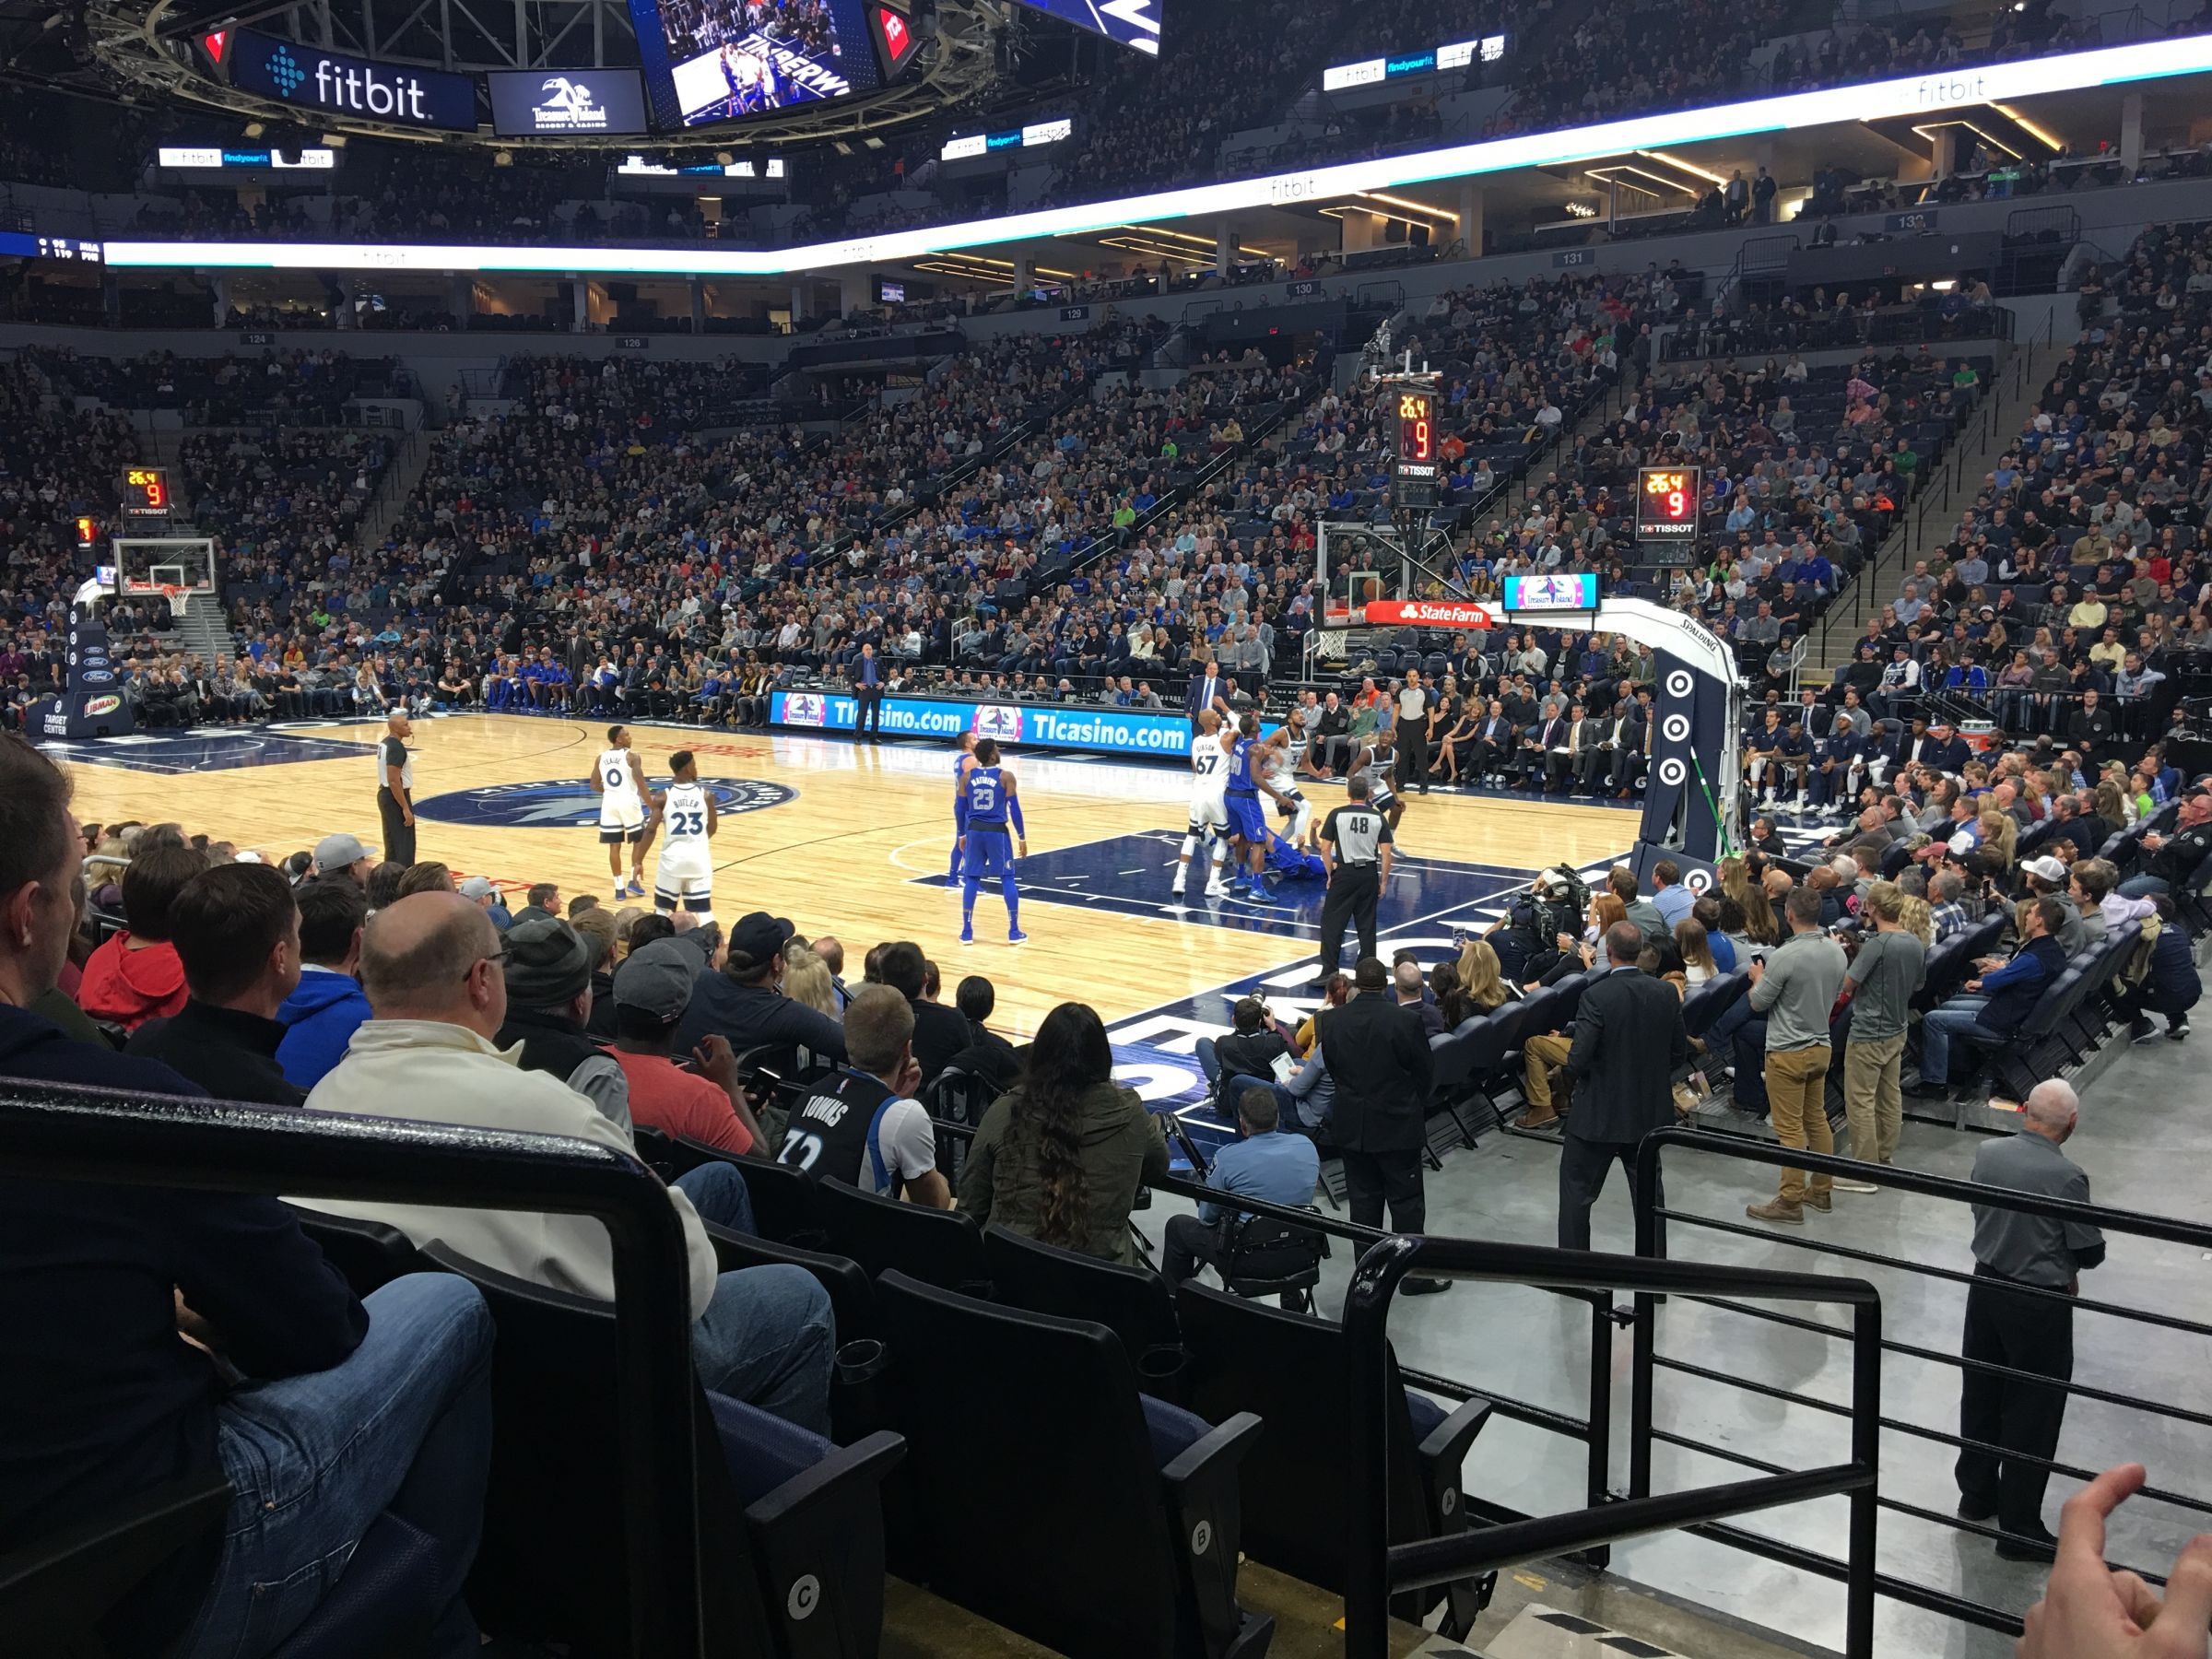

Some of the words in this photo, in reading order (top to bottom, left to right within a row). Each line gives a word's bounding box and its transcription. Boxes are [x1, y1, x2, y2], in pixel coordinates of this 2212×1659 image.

[886, 14, 902, 41] TCL
[314, 59, 425, 120] fitbit
[1919, 76, 1984, 103] fitbit
[1272, 177, 1314, 199] fitbit
[1563, 253, 1583, 264] 131
[1295, 284, 1312, 294] 130
[1067, 309, 1082, 319] 129
[249, 335, 265, 343] 124
[624, 338, 641, 347] 126
[1400, 395, 1425, 418] 26.4
[1416, 421, 1428, 458] 9
[128, 471, 155, 485] 26.4
[1409, 465, 1435, 476] TISSOT
[1647, 473, 1683, 493] 26.4
[147, 484, 161, 505] 9
[1669, 491, 1683, 516] 9
[1654, 524, 1694, 533] TISSOT
[1679, 618, 1720, 652] SPALDING
[84, 698, 117, 715] LIBMAN
[44, 714, 67, 725] TARGET
[43, 724, 67, 735] CENTER
[1196, 755, 1219, 775] 67
[606, 768, 623, 787] 0
[673, 798, 700, 809] BUTLER
[972, 788, 995, 811] 23
[671, 812, 704, 836] 23
[1349, 817, 1369, 834] 48
[801, 1095, 849, 1127] TOWNS
[1198, 1529, 1206, 1547] B
[797, 1585, 811, 1608] C
